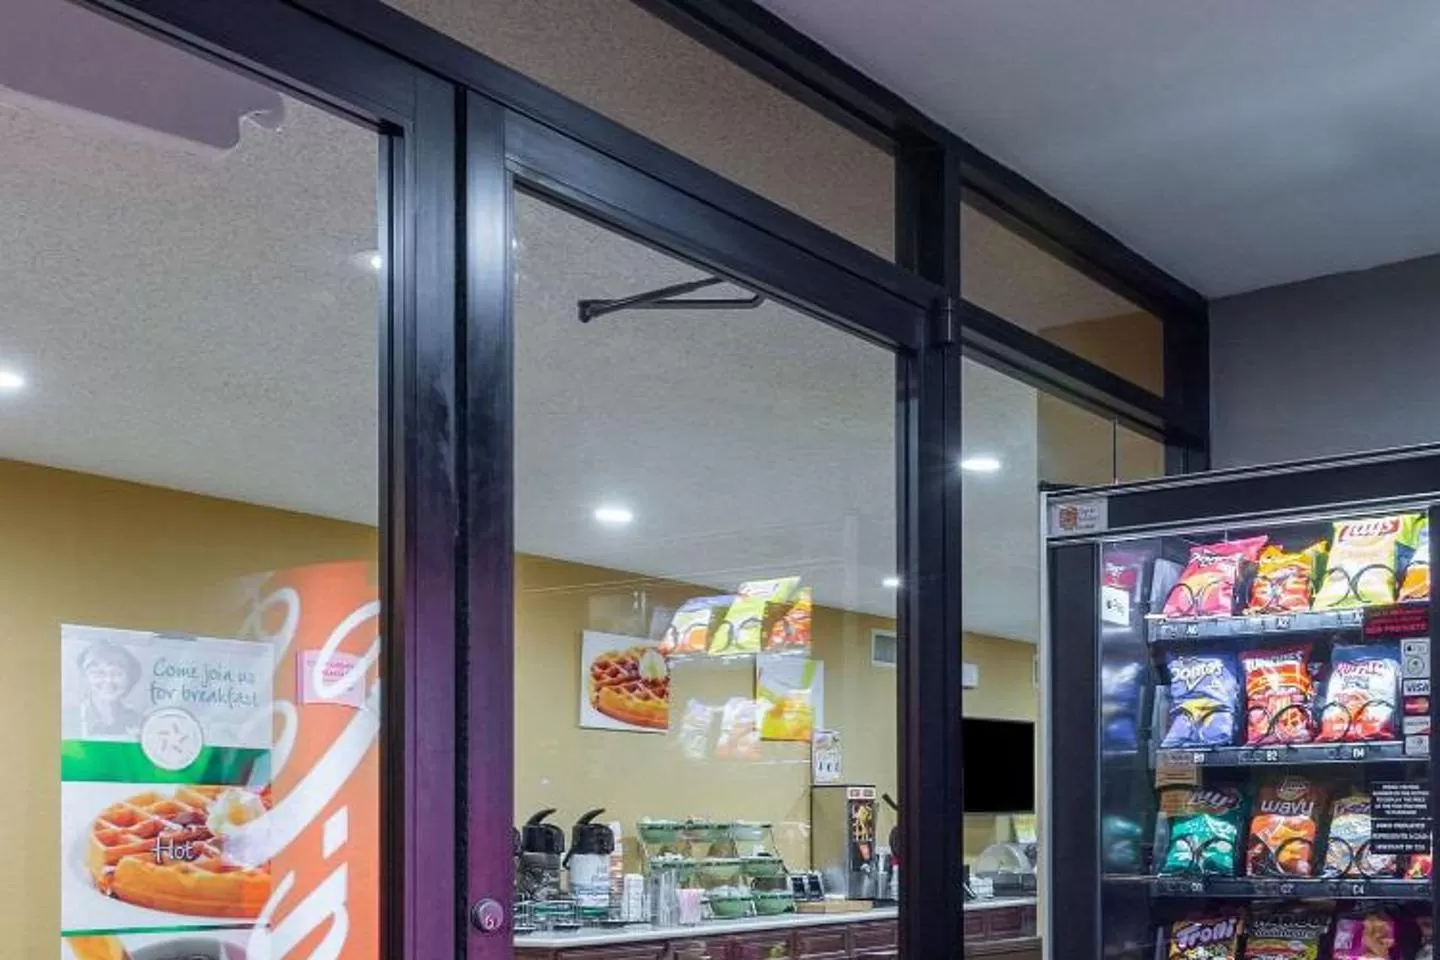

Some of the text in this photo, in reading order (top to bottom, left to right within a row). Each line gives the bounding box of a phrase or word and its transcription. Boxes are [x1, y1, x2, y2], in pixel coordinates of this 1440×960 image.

[152, 656, 199, 678] Come
[203, 661, 233, 687] join
[144, 680, 260, 709] for breakfast
[153, 832, 195, 863] Hot
